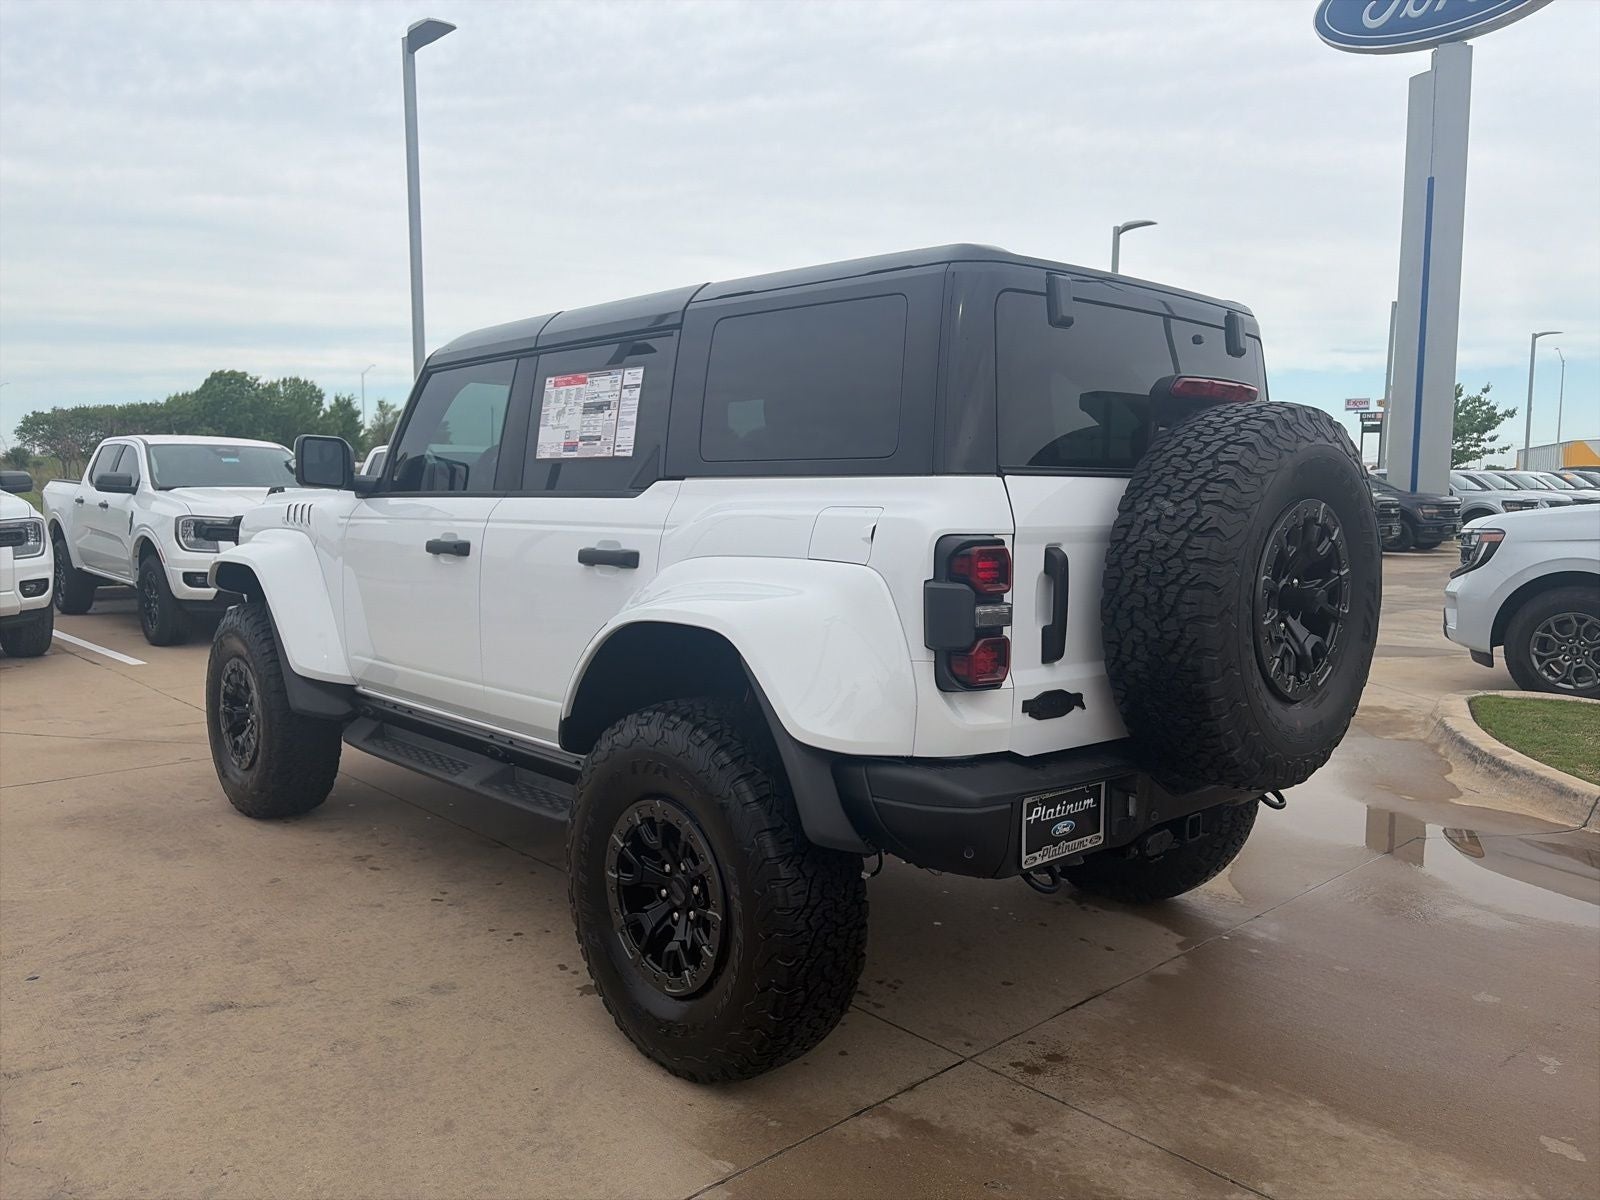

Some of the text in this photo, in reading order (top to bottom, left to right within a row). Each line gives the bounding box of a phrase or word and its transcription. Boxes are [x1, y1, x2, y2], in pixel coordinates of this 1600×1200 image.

[1346, 400, 1369, 408] Exxon
[1026, 798, 1097, 824] Platinum
[1055, 823, 1072, 835] Ford
[1041, 840, 1086, 861] Platinum
